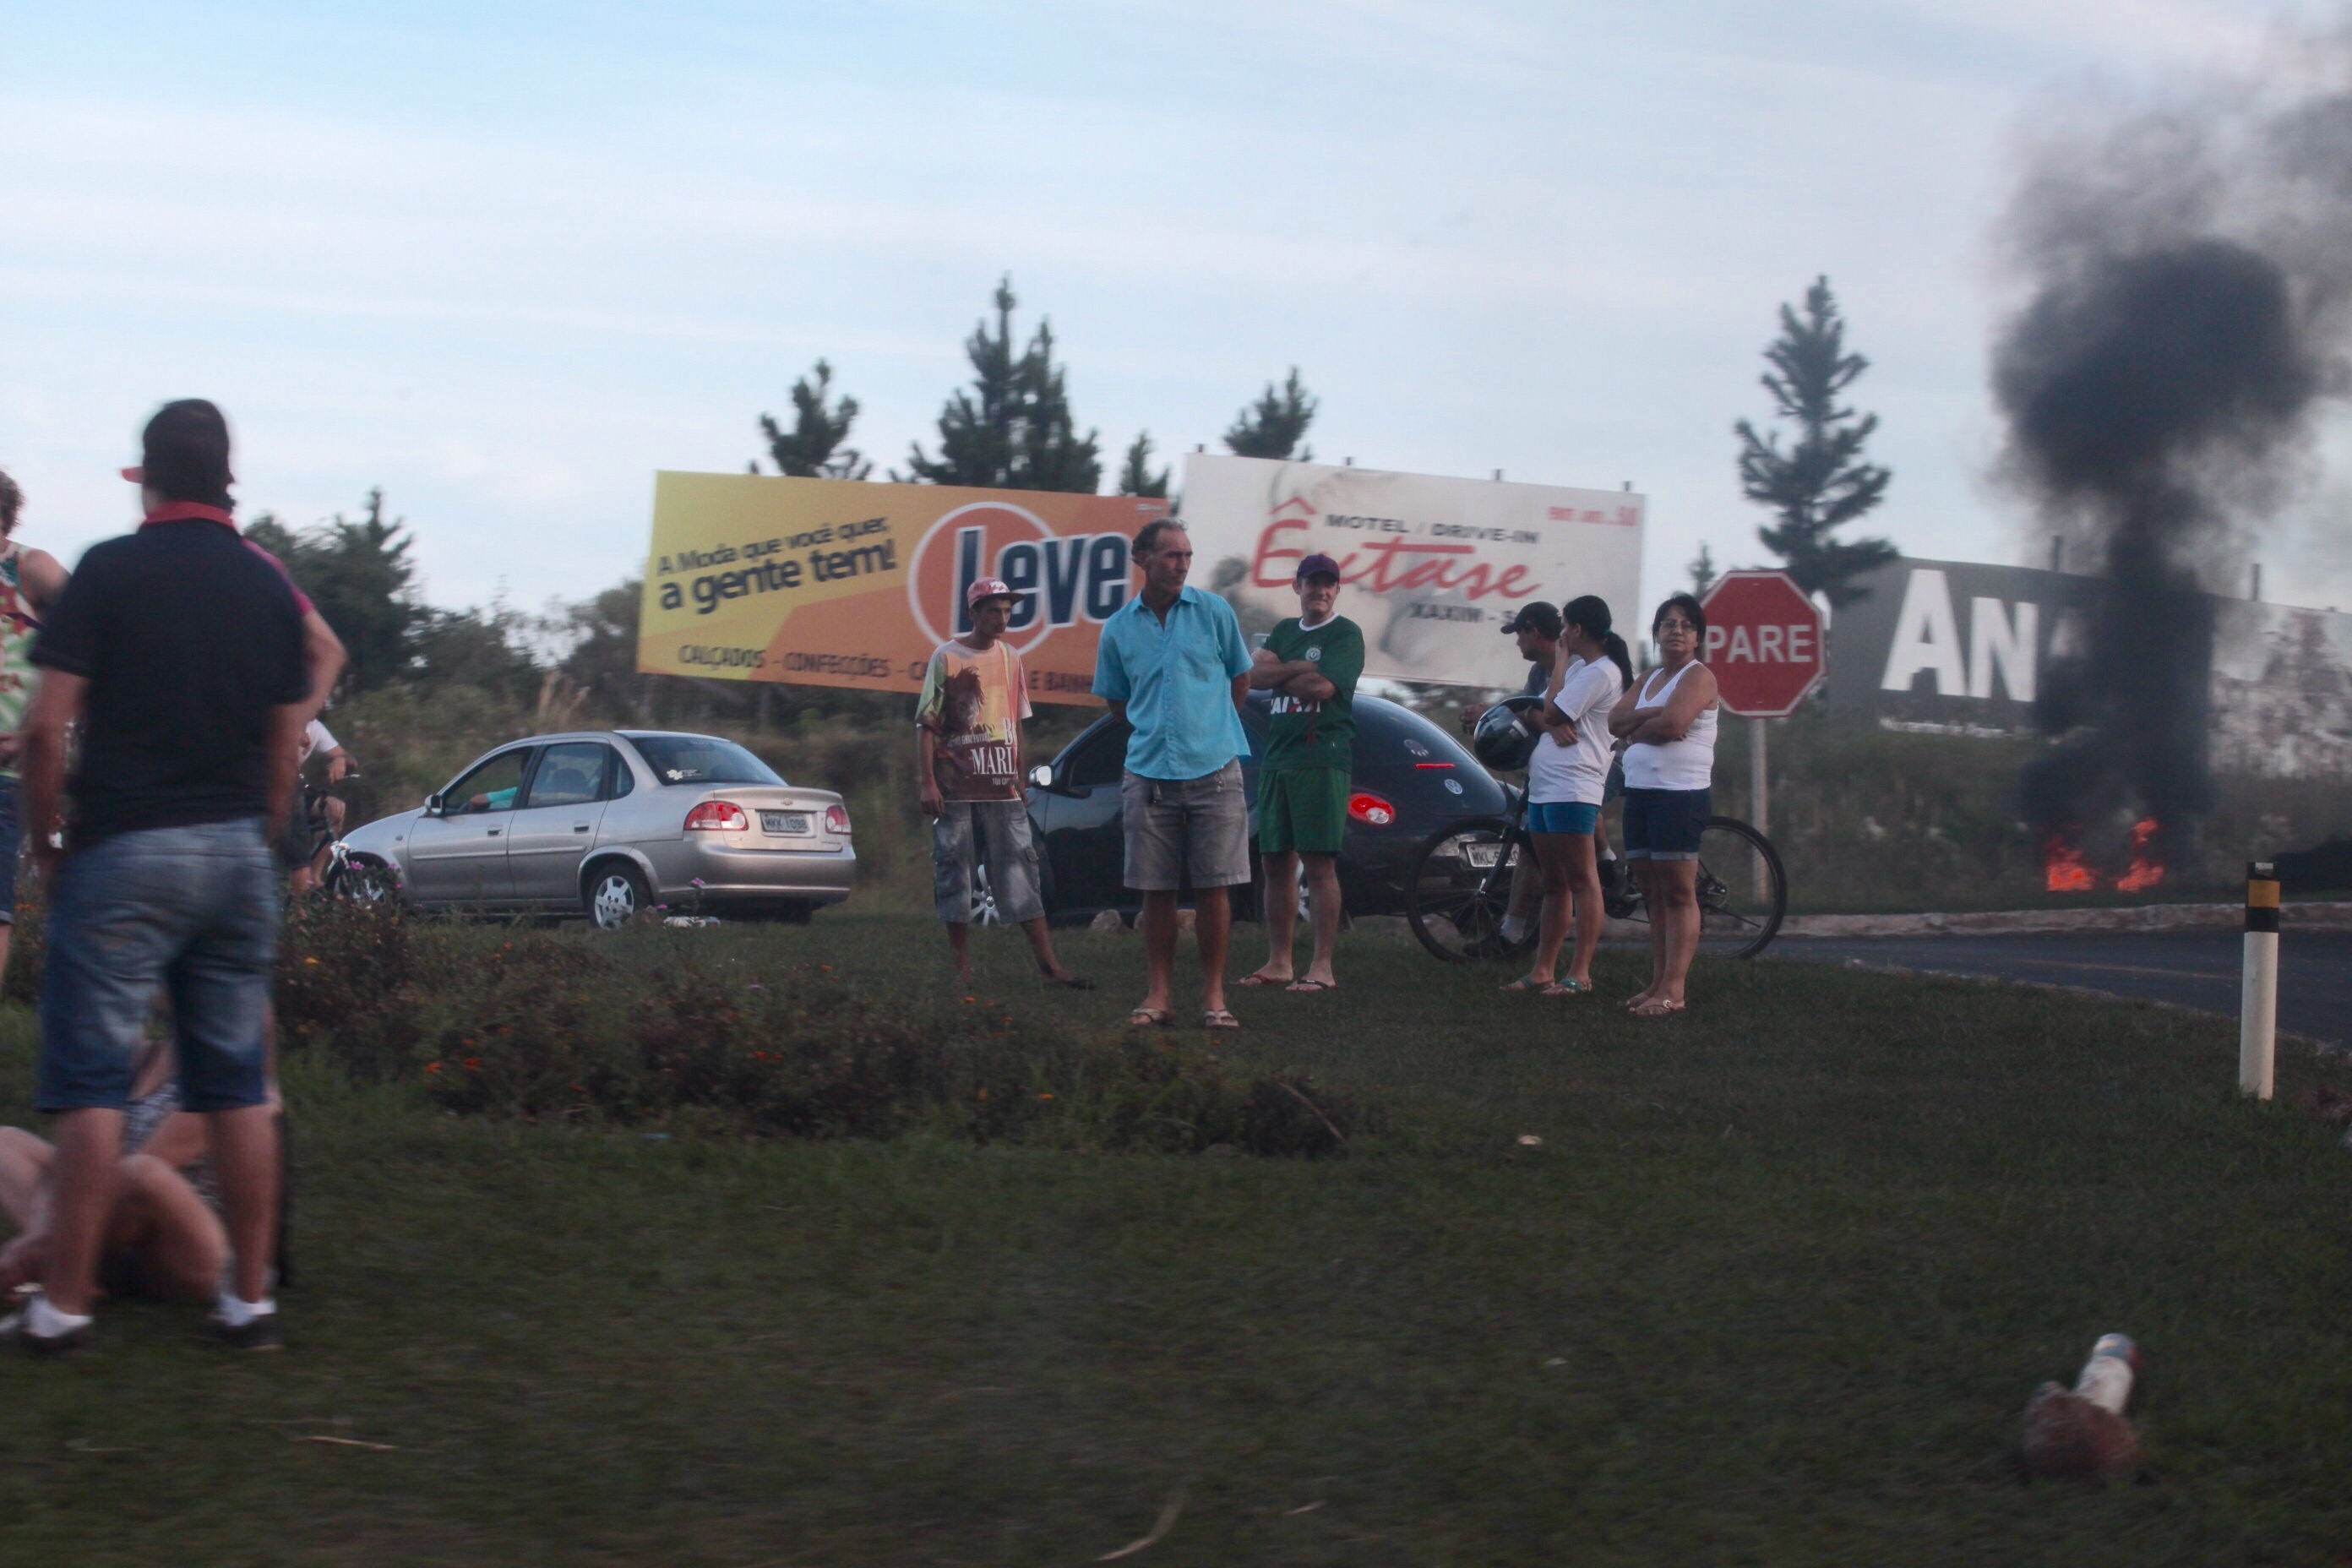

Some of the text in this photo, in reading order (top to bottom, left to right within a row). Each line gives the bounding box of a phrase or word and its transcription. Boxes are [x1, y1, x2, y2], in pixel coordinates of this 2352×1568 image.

[658, 555, 673, 576] A
[678, 545, 737, 571] Moda
[742, 537, 781, 561] que
[787, 522, 834, 549] você
[1324, 514, 1541, 544] MOTEL DRIVE-IN
[660, 537, 897, 615] a gente tem!
[952, 525, 1132, 637] Leve
[678, 644, 765, 672] CALÇADOS
[782, 651, 890, 681] CONFECÇÕES
[1705, 623, 1812, 664] PARE
[970, 746, 1018, 775] MARL
